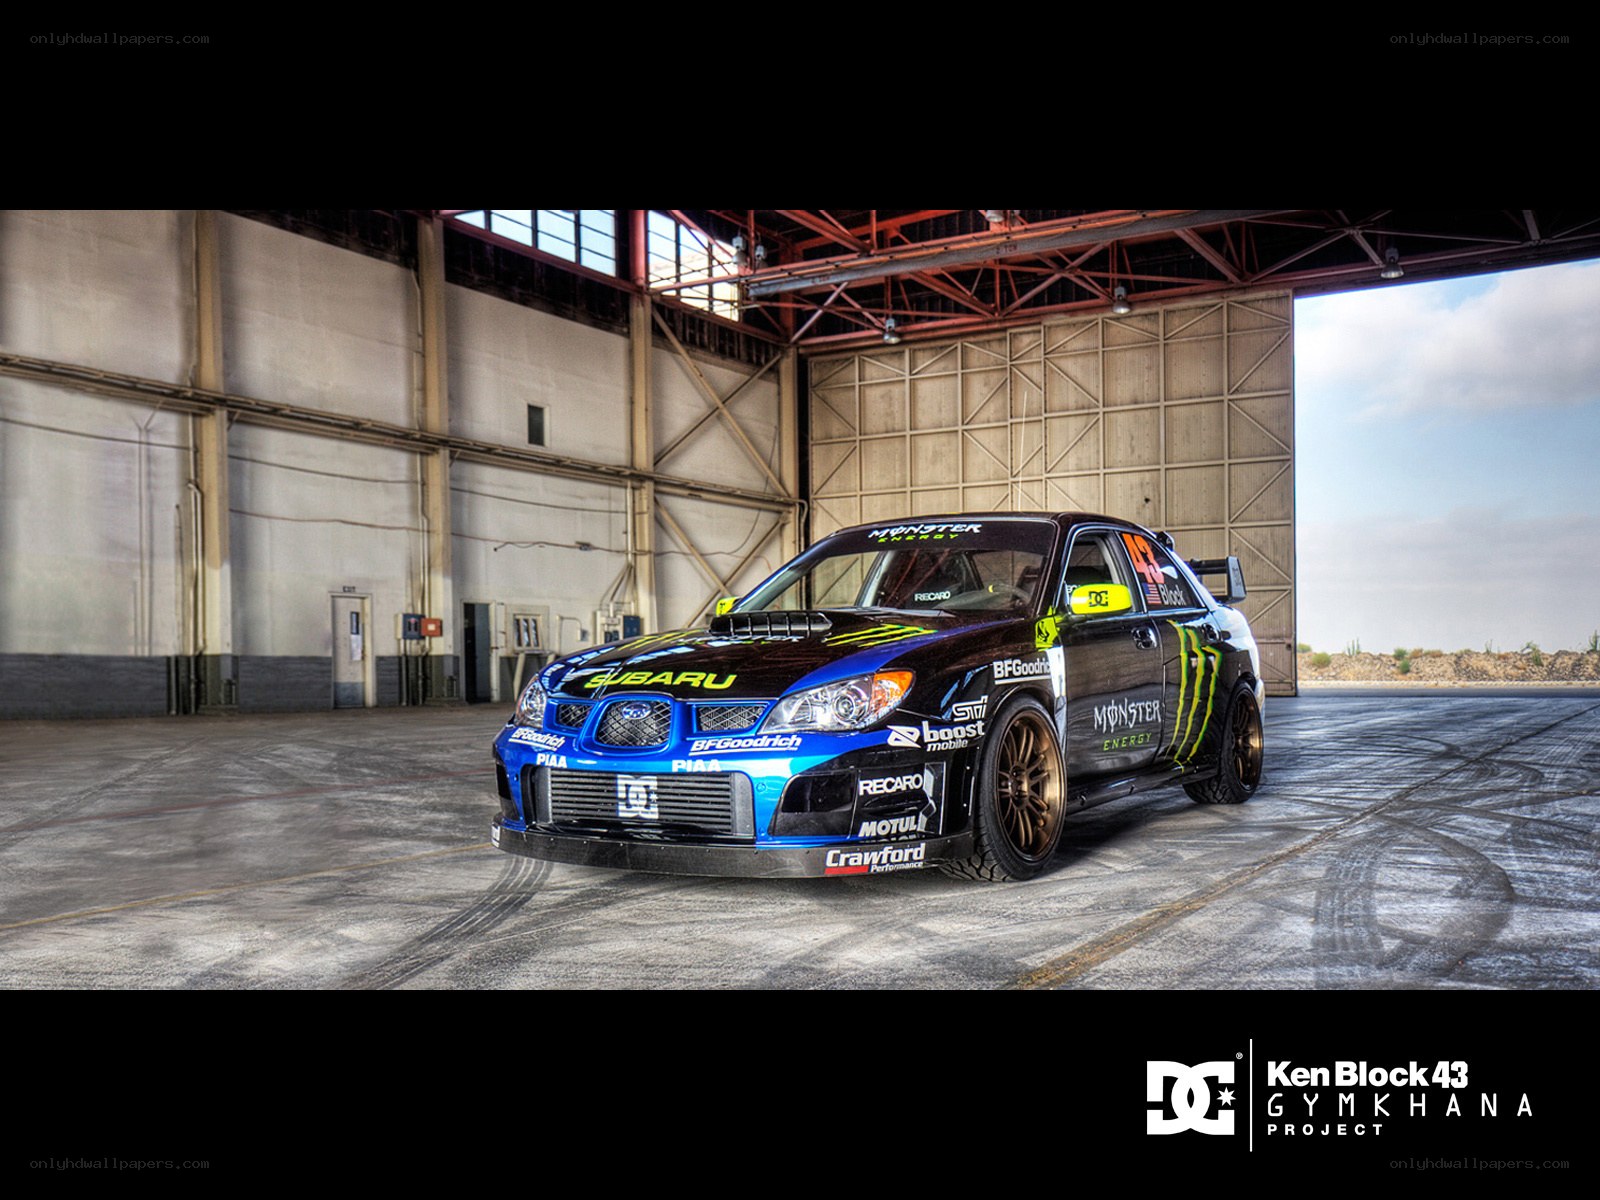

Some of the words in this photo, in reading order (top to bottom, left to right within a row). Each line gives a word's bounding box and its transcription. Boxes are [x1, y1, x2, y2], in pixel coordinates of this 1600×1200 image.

[877, 534, 959, 543] ENERGY
[1122, 533, 1165, 584] 43
[914, 591, 951, 601] RECARO
[1089, 590, 1108, 607] DC
[1159, 583, 1186, 606] Block
[584, 671, 737, 690] SUBARU
[511, 727, 566, 749] BFGoodrich
[922, 720, 985, 743] boost
[690, 735, 802, 752] BFGoodrich
[926, 739, 968, 752] mobile
[1103, 733, 1152, 751] ENERGY
[536, 753, 567, 768] PIAA
[671, 759, 722, 772] PIAA
[859, 773, 923, 796] RECARO
[616, 774, 659, 819] DC
[858, 815, 917, 837] MOTUL
[826, 843, 926, 867] Crawford
[870, 861, 924, 873] Performance
